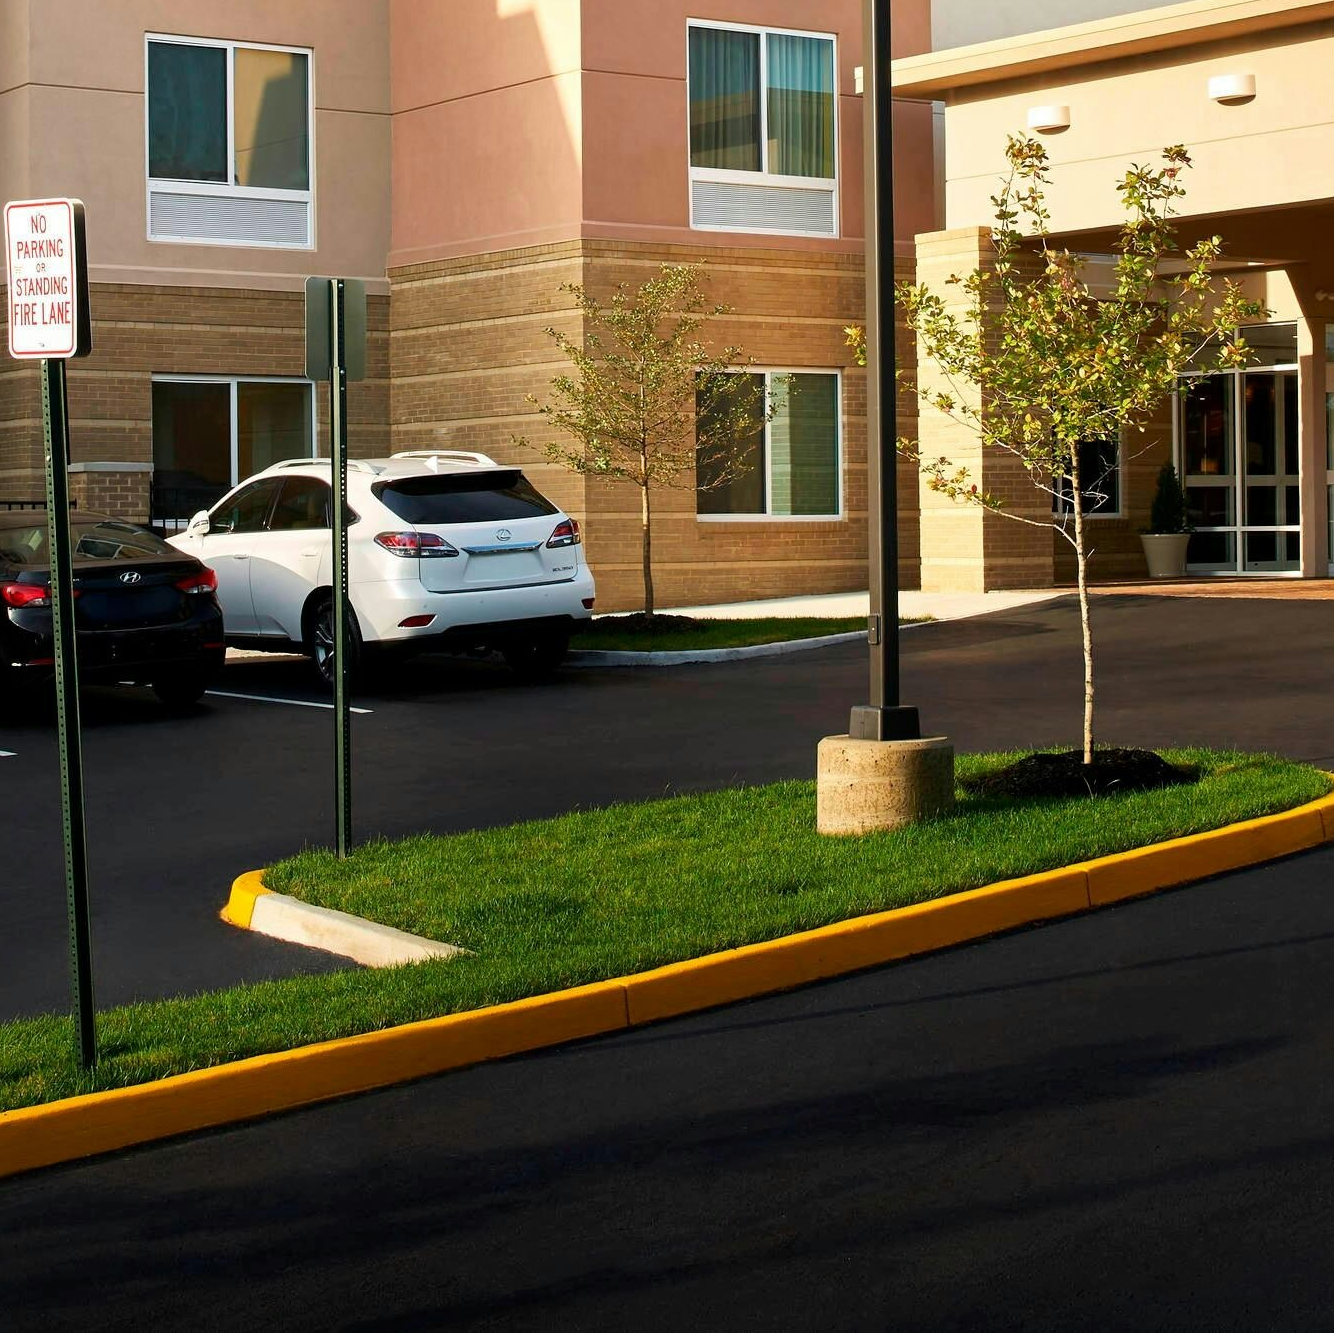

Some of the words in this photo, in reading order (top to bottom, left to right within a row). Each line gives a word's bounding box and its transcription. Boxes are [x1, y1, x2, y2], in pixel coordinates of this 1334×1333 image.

[30, 215, 47, 233] NO
[17, 239, 64, 259] PARKING
[35, 262, 46, 273] OR
[16, 276, 68, 296] STANDING
[14, 303, 38, 326] FIRE
[42, 301, 71, 325] LANE
